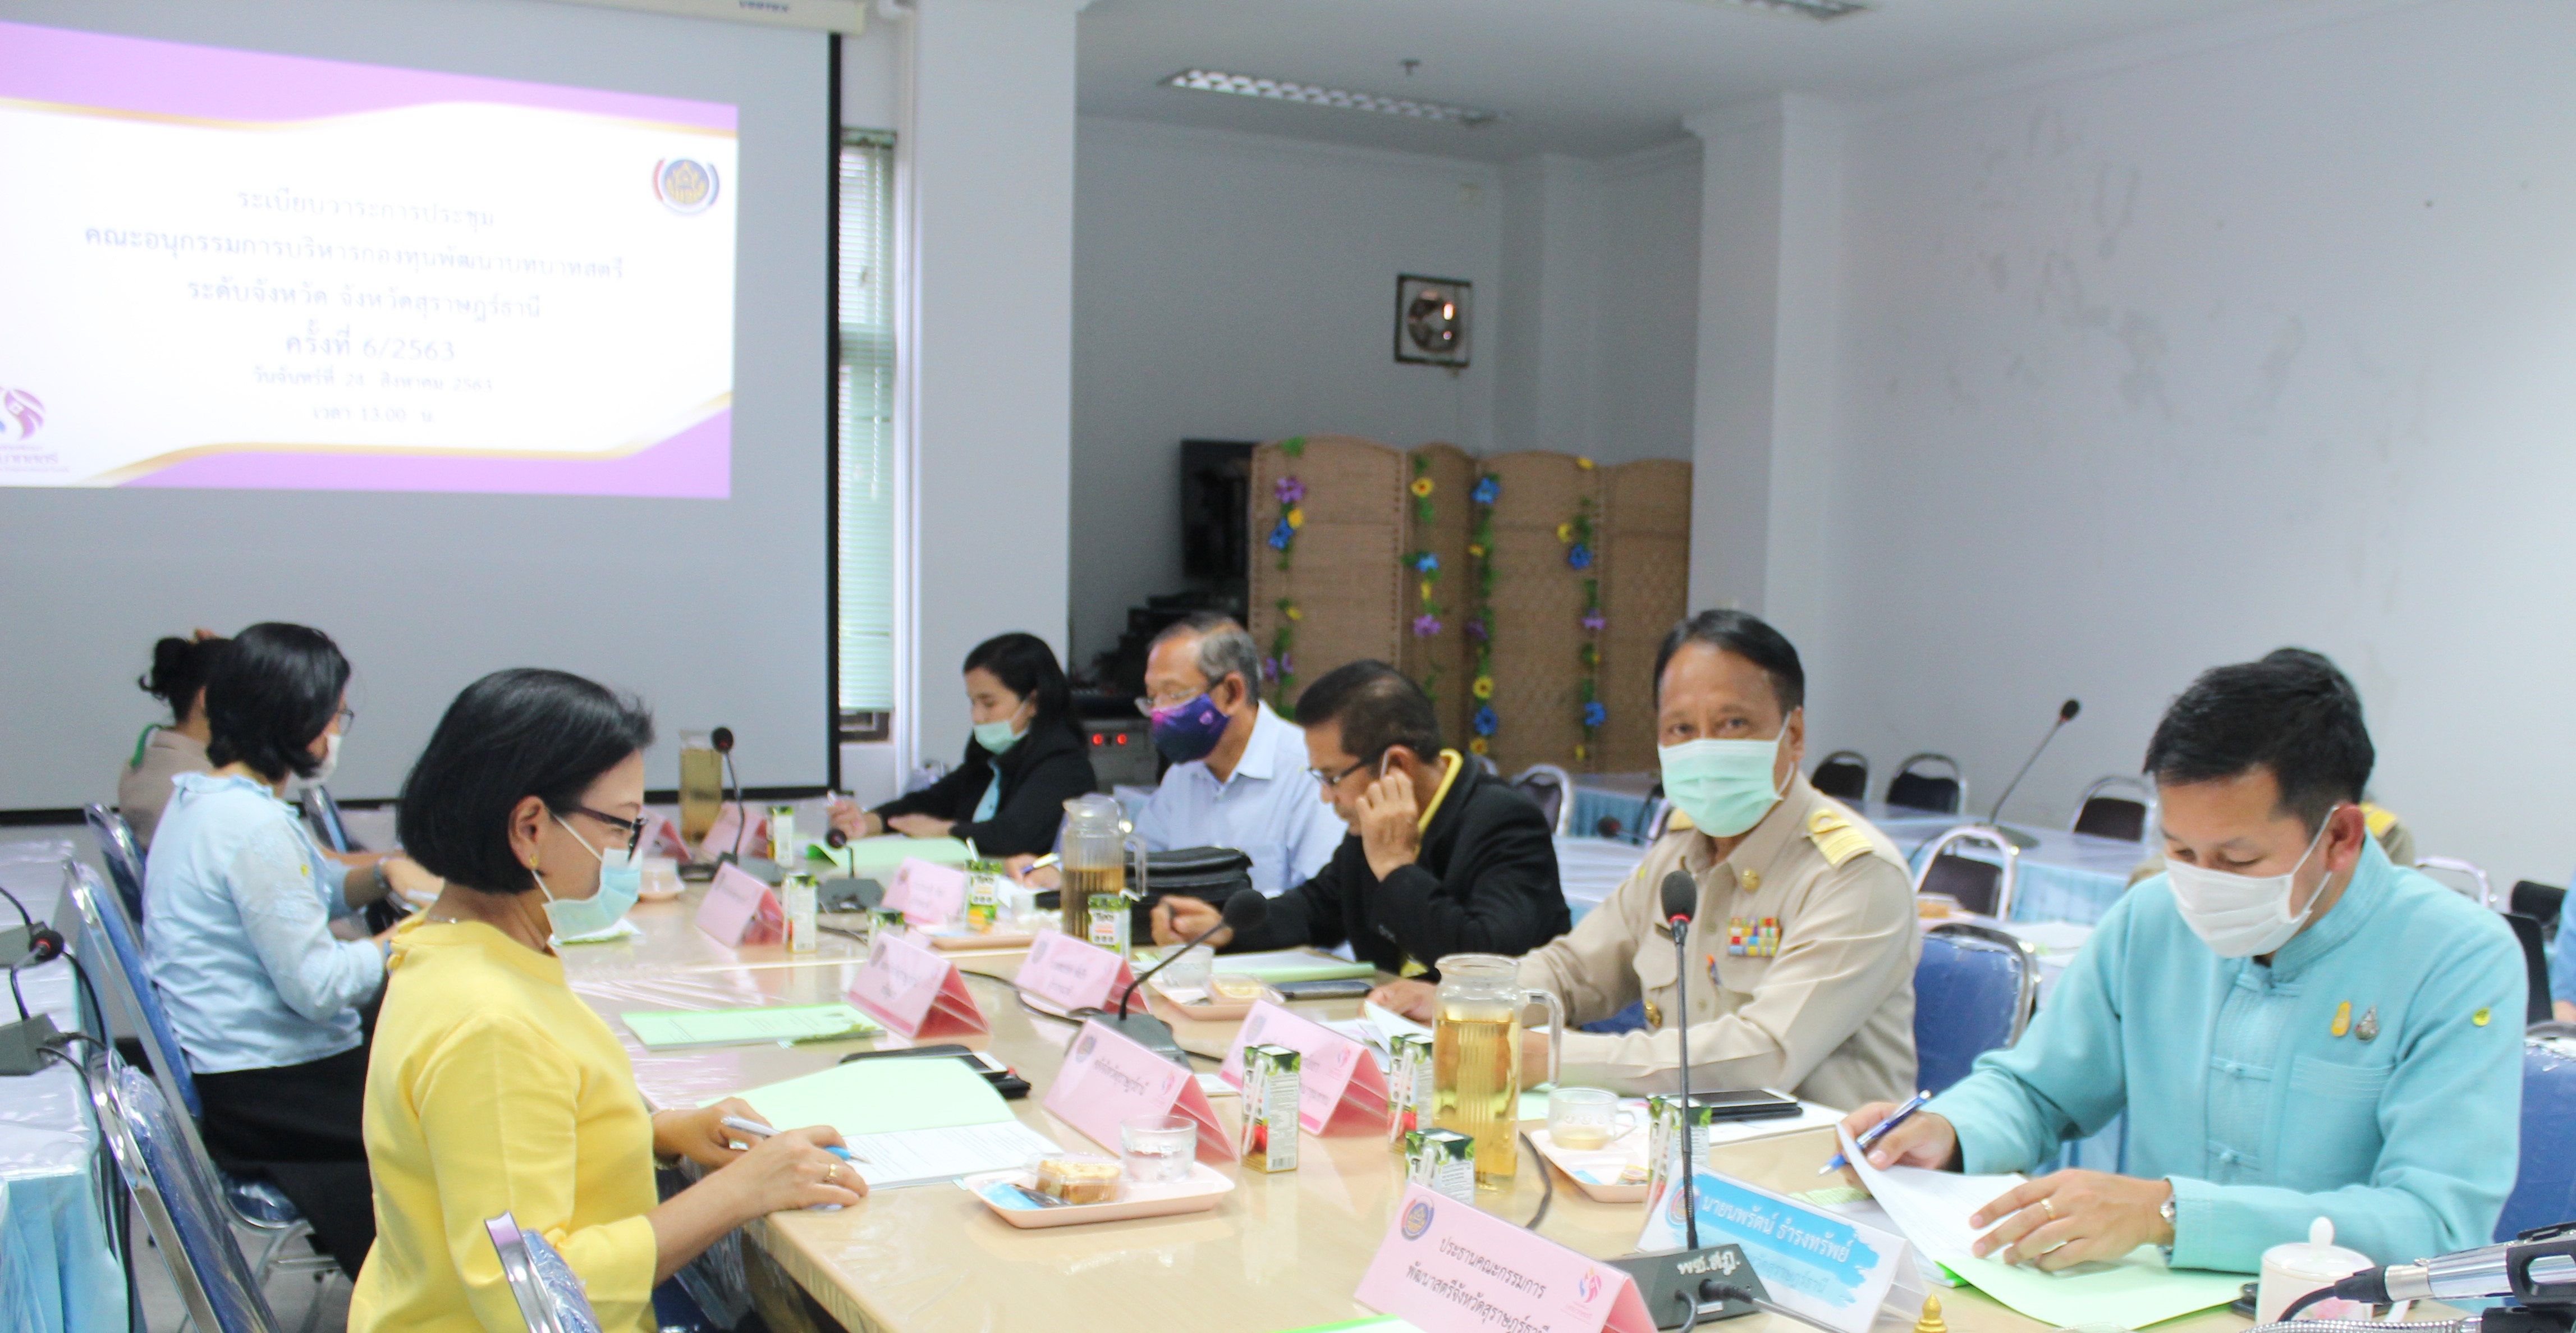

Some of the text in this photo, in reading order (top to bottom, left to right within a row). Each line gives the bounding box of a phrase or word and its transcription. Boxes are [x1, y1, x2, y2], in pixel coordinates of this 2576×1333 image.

[237, 187, 494, 233] ระเบียบวาระการประชุม
[85, 226, 623, 280] คณะอนุกรรมการบริหารกองทุนพัฒนาบทบาทสตรี
[187, 275, 540, 323] ระดับจังหวัด จังหวัดสุราษฎร์ธานี
[285, 318, 455, 362] ครั้งที่ 6/2563
[1702, 1195, 1854, 1263] นายนพรัตน์ ธำรงทรัพย์
[1440, 1236, 1547, 1299] ประธานคณะกรรมการ
